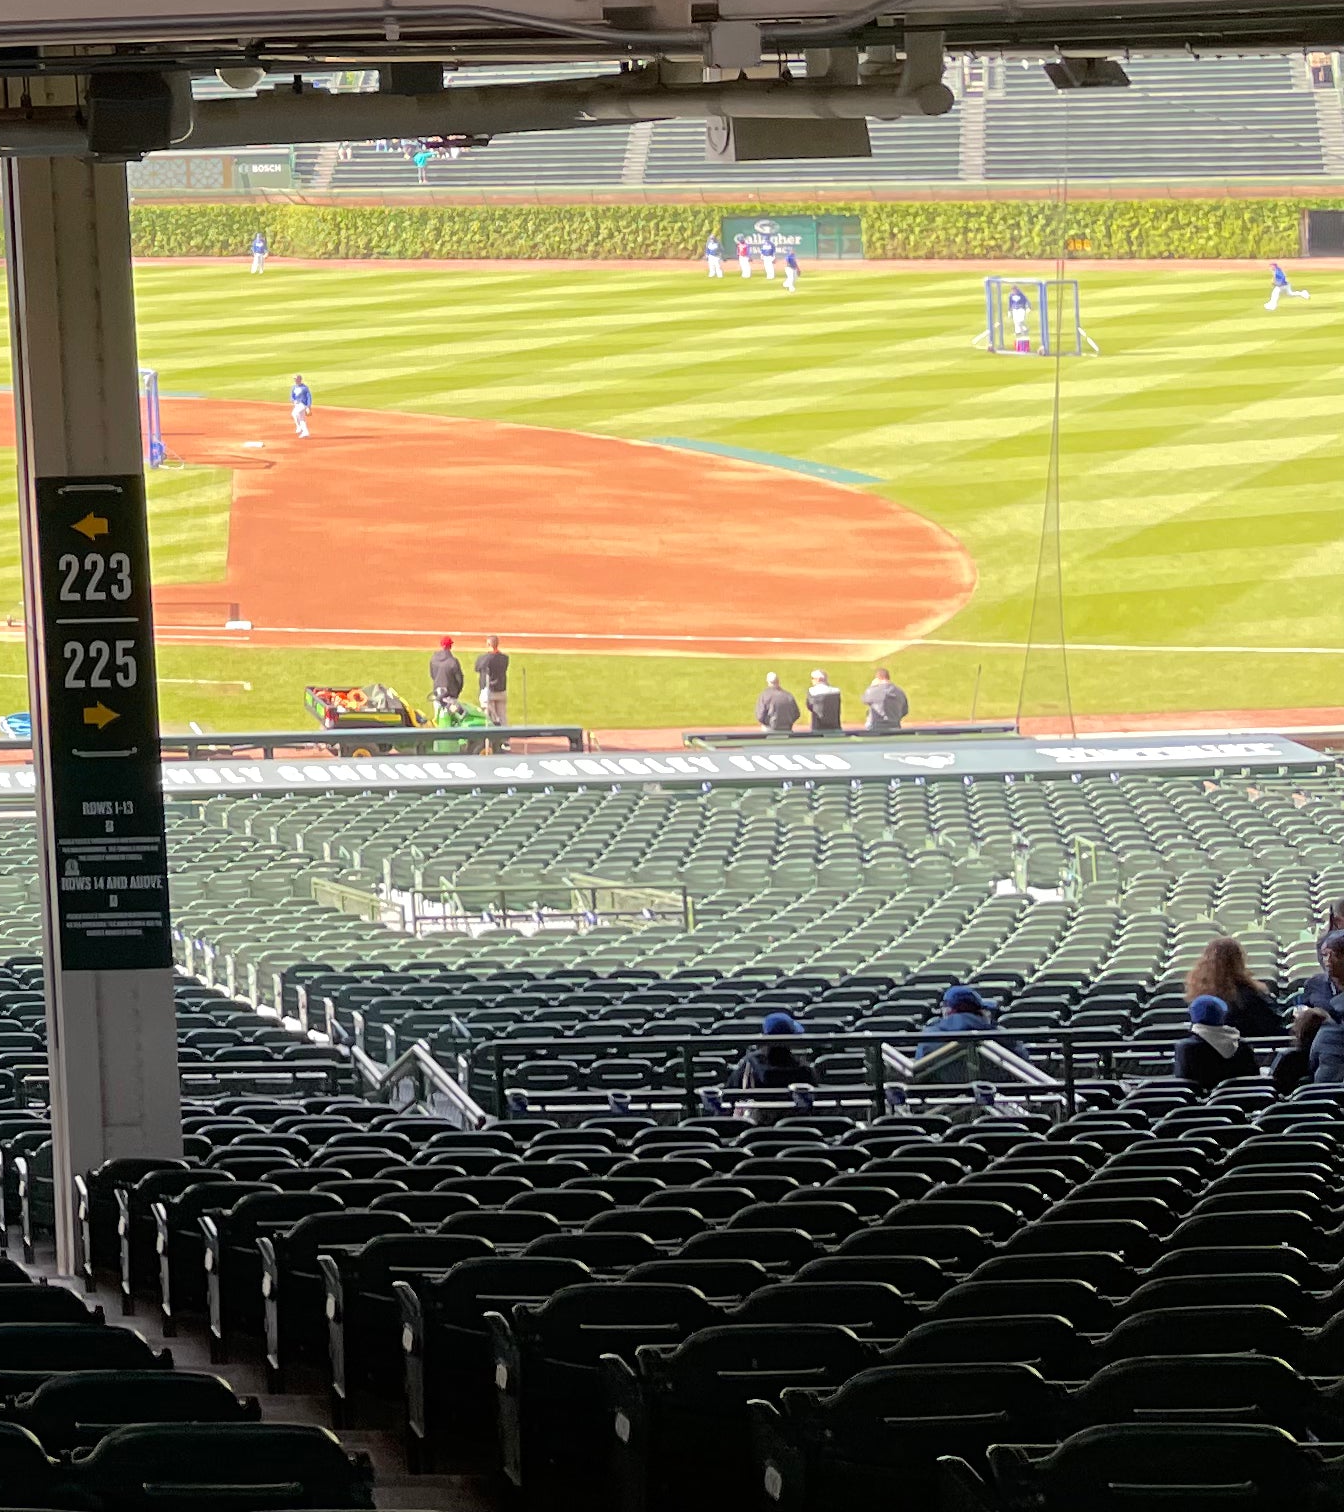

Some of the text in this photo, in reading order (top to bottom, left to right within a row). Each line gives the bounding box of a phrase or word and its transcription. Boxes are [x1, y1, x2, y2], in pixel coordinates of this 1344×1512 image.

[252, 163, 282, 173] BOSCH
[58, 552, 132, 602] 223
[63, 640, 138, 689] 225
[82, 800, 134, 815] ROWS 1-13
[61, 874, 163, 891] ROWS 14 AND ABOVE
